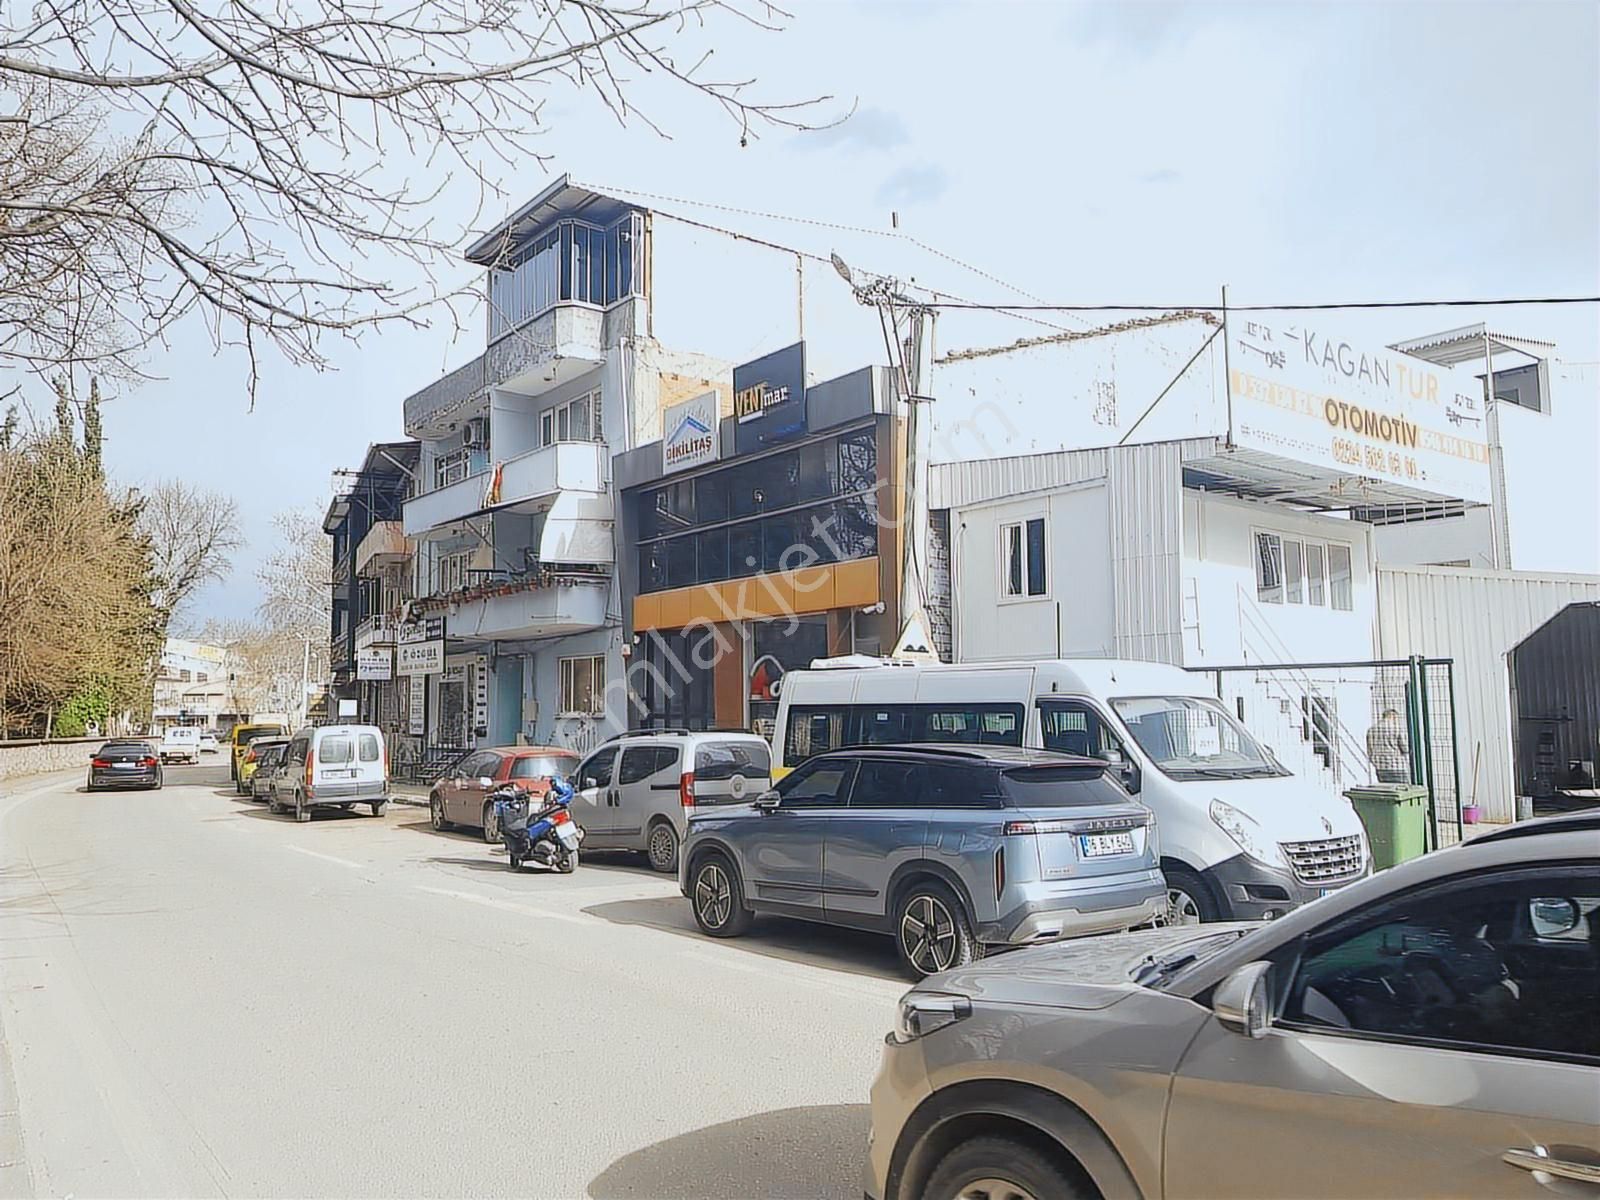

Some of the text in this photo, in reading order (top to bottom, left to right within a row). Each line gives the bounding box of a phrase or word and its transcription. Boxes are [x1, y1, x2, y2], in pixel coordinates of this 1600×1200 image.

[1303, 328, 1390, 387] KAGAN
[1395, 363, 1439, 404] TUR
[666, 436, 712, 460] DİKİLİTAŞ
[1324, 397, 1418, 449] OTOMOTİV
